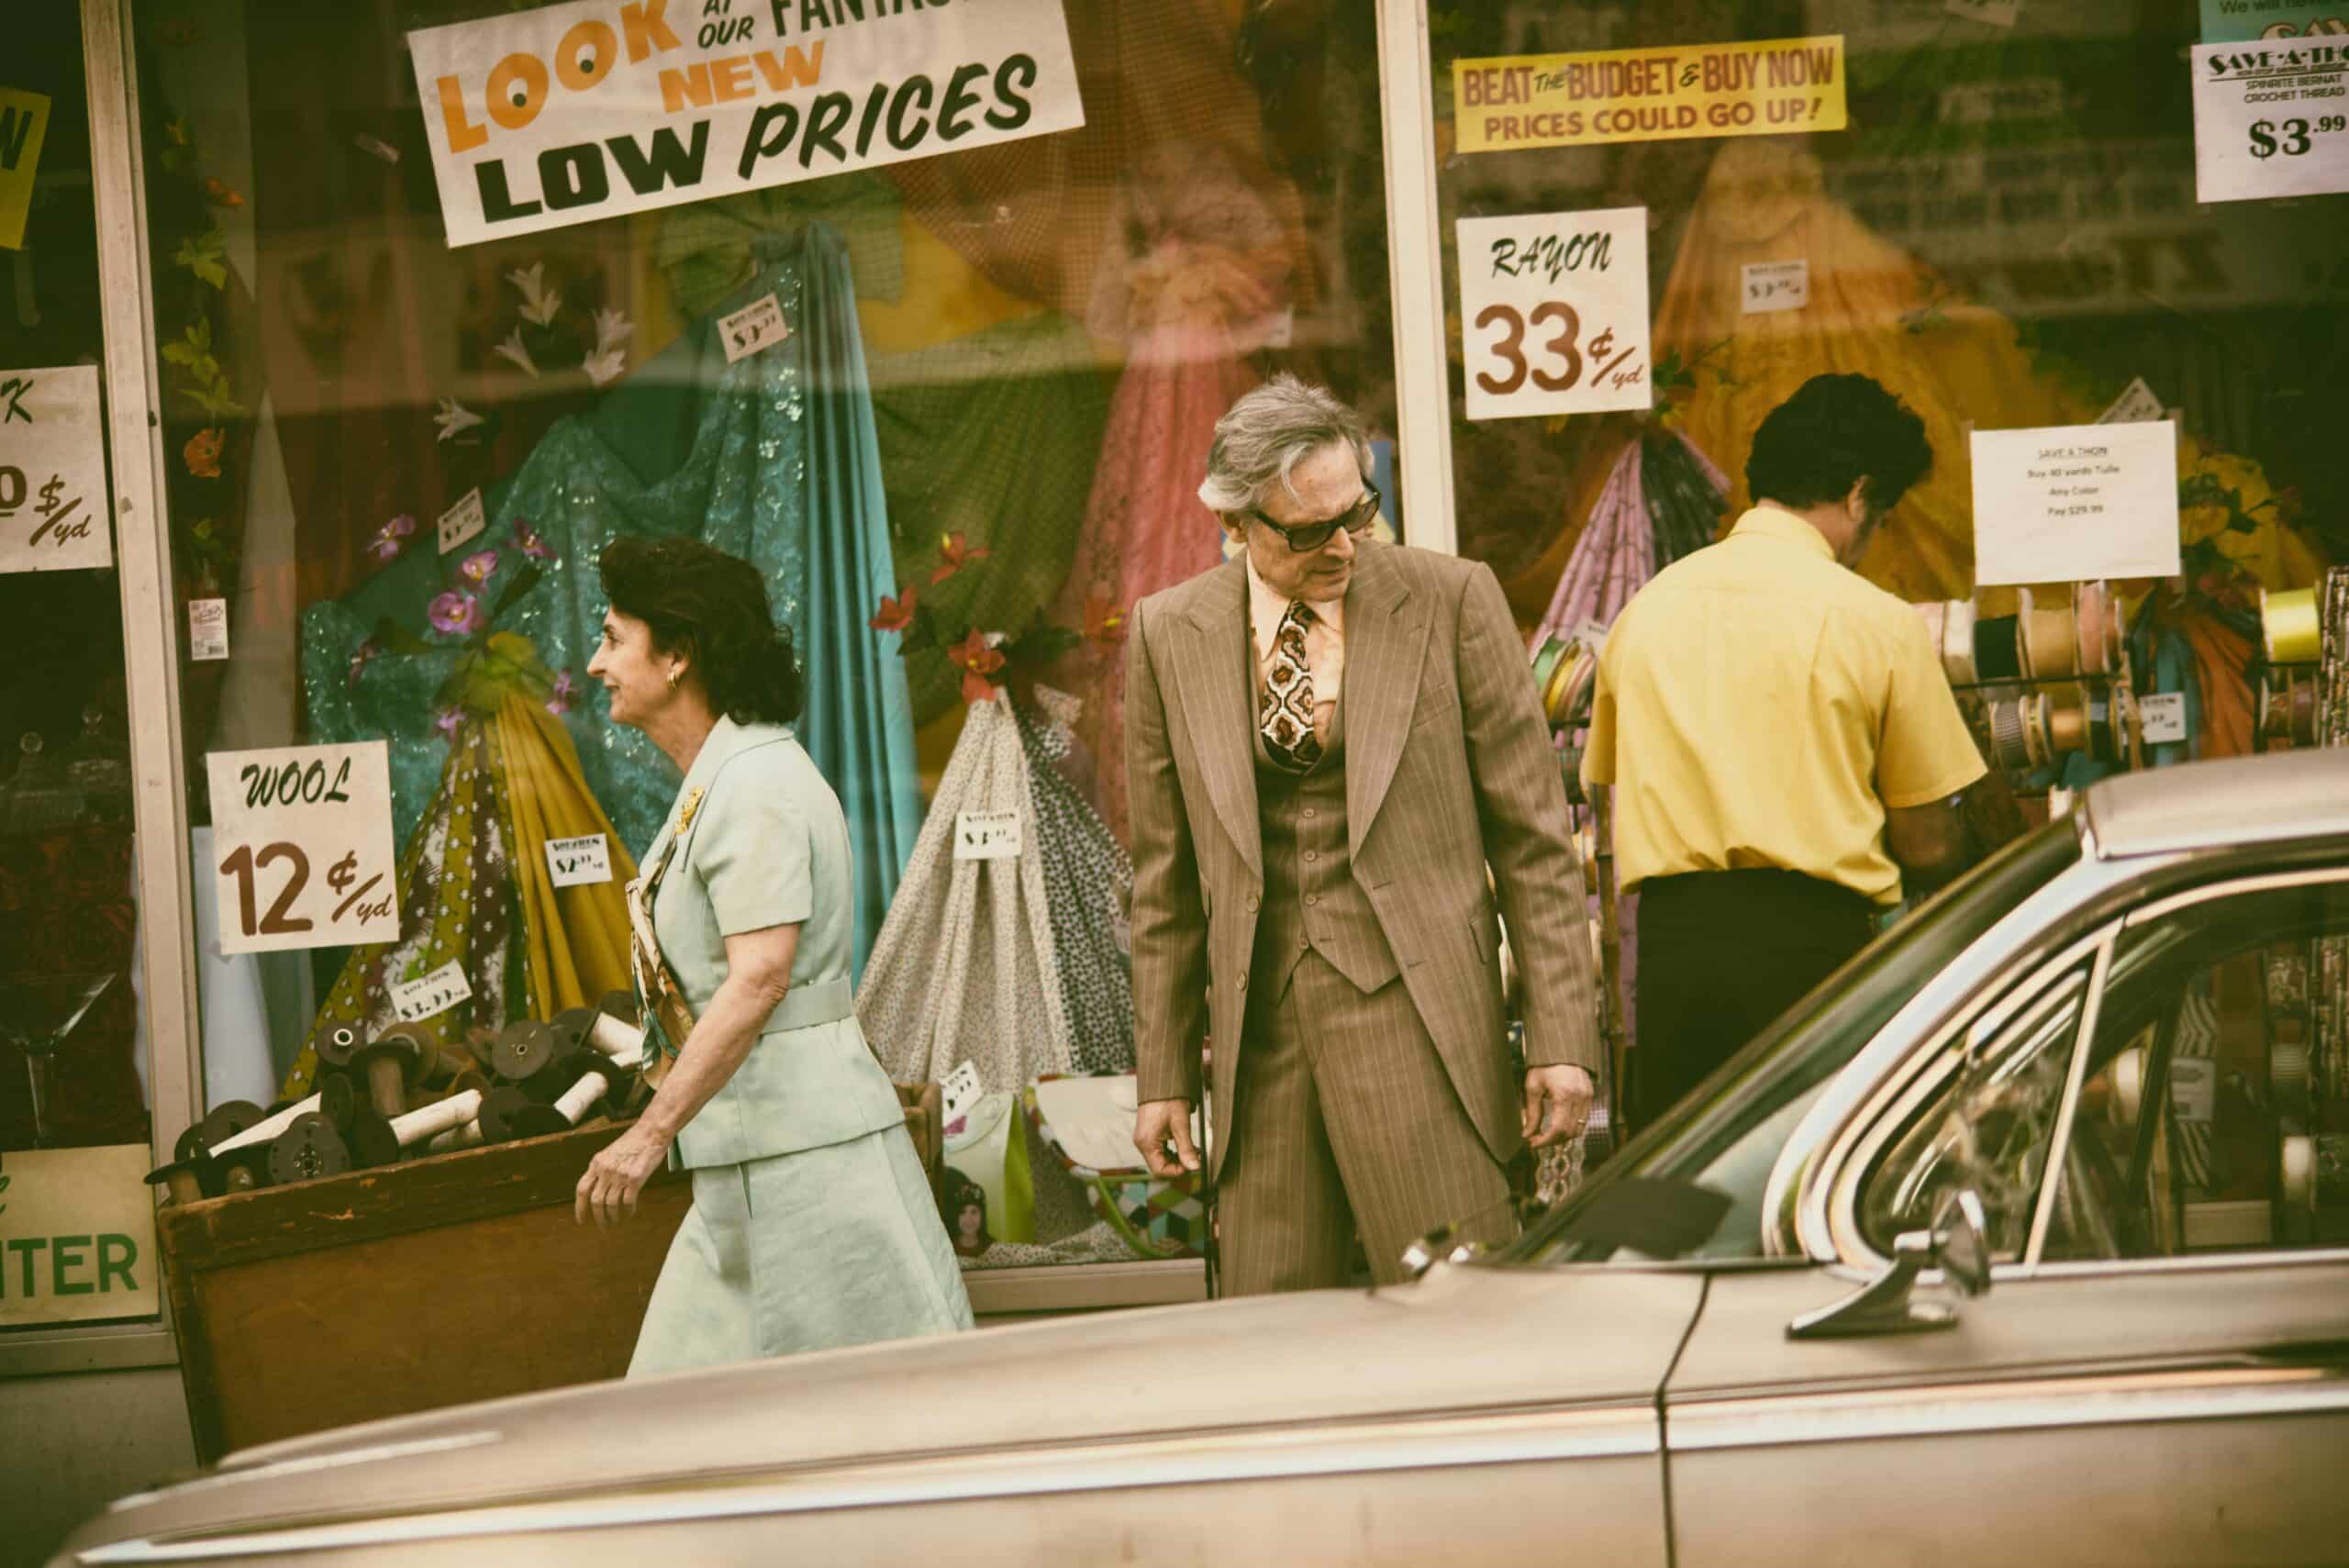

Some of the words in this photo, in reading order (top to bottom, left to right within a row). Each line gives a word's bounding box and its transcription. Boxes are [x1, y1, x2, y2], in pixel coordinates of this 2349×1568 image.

[697, 16, 754, 49] OUR
[436, 0, 682, 153] LOOK
[659, 39, 825, 114] NEW
[1463, 66, 1534, 107] BEAT
[1533, 70, 1564, 93] THE
[1567, 57, 1678, 102] BUDGET
[1678, 63, 1700, 88] &
[1703, 50, 1760, 94] BUY
[1767, 47, 1835, 90] NOW
[2244, 90, 2296, 104] CROCHET
[2299, 86, 2346, 99] THREAD
[2297, 73, 2343, 86] BERNAT
[473, 120, 711, 225] LOW
[738, 53, 1038, 181] PRICES
[1485, 112, 1584, 142] PRICES
[1593, 105, 1698, 134] COULD
[1707, 101, 1755, 128] GO
[1766, 96, 1823, 125] UP!
[2249, 115, 2346, 161] $3.99
[1491, 231, 1613, 284] RAYON
[2048, 487, 2069, 497] Any
[240, 755, 351, 809] WOOL
[0, 1233, 139, 1300] TER
